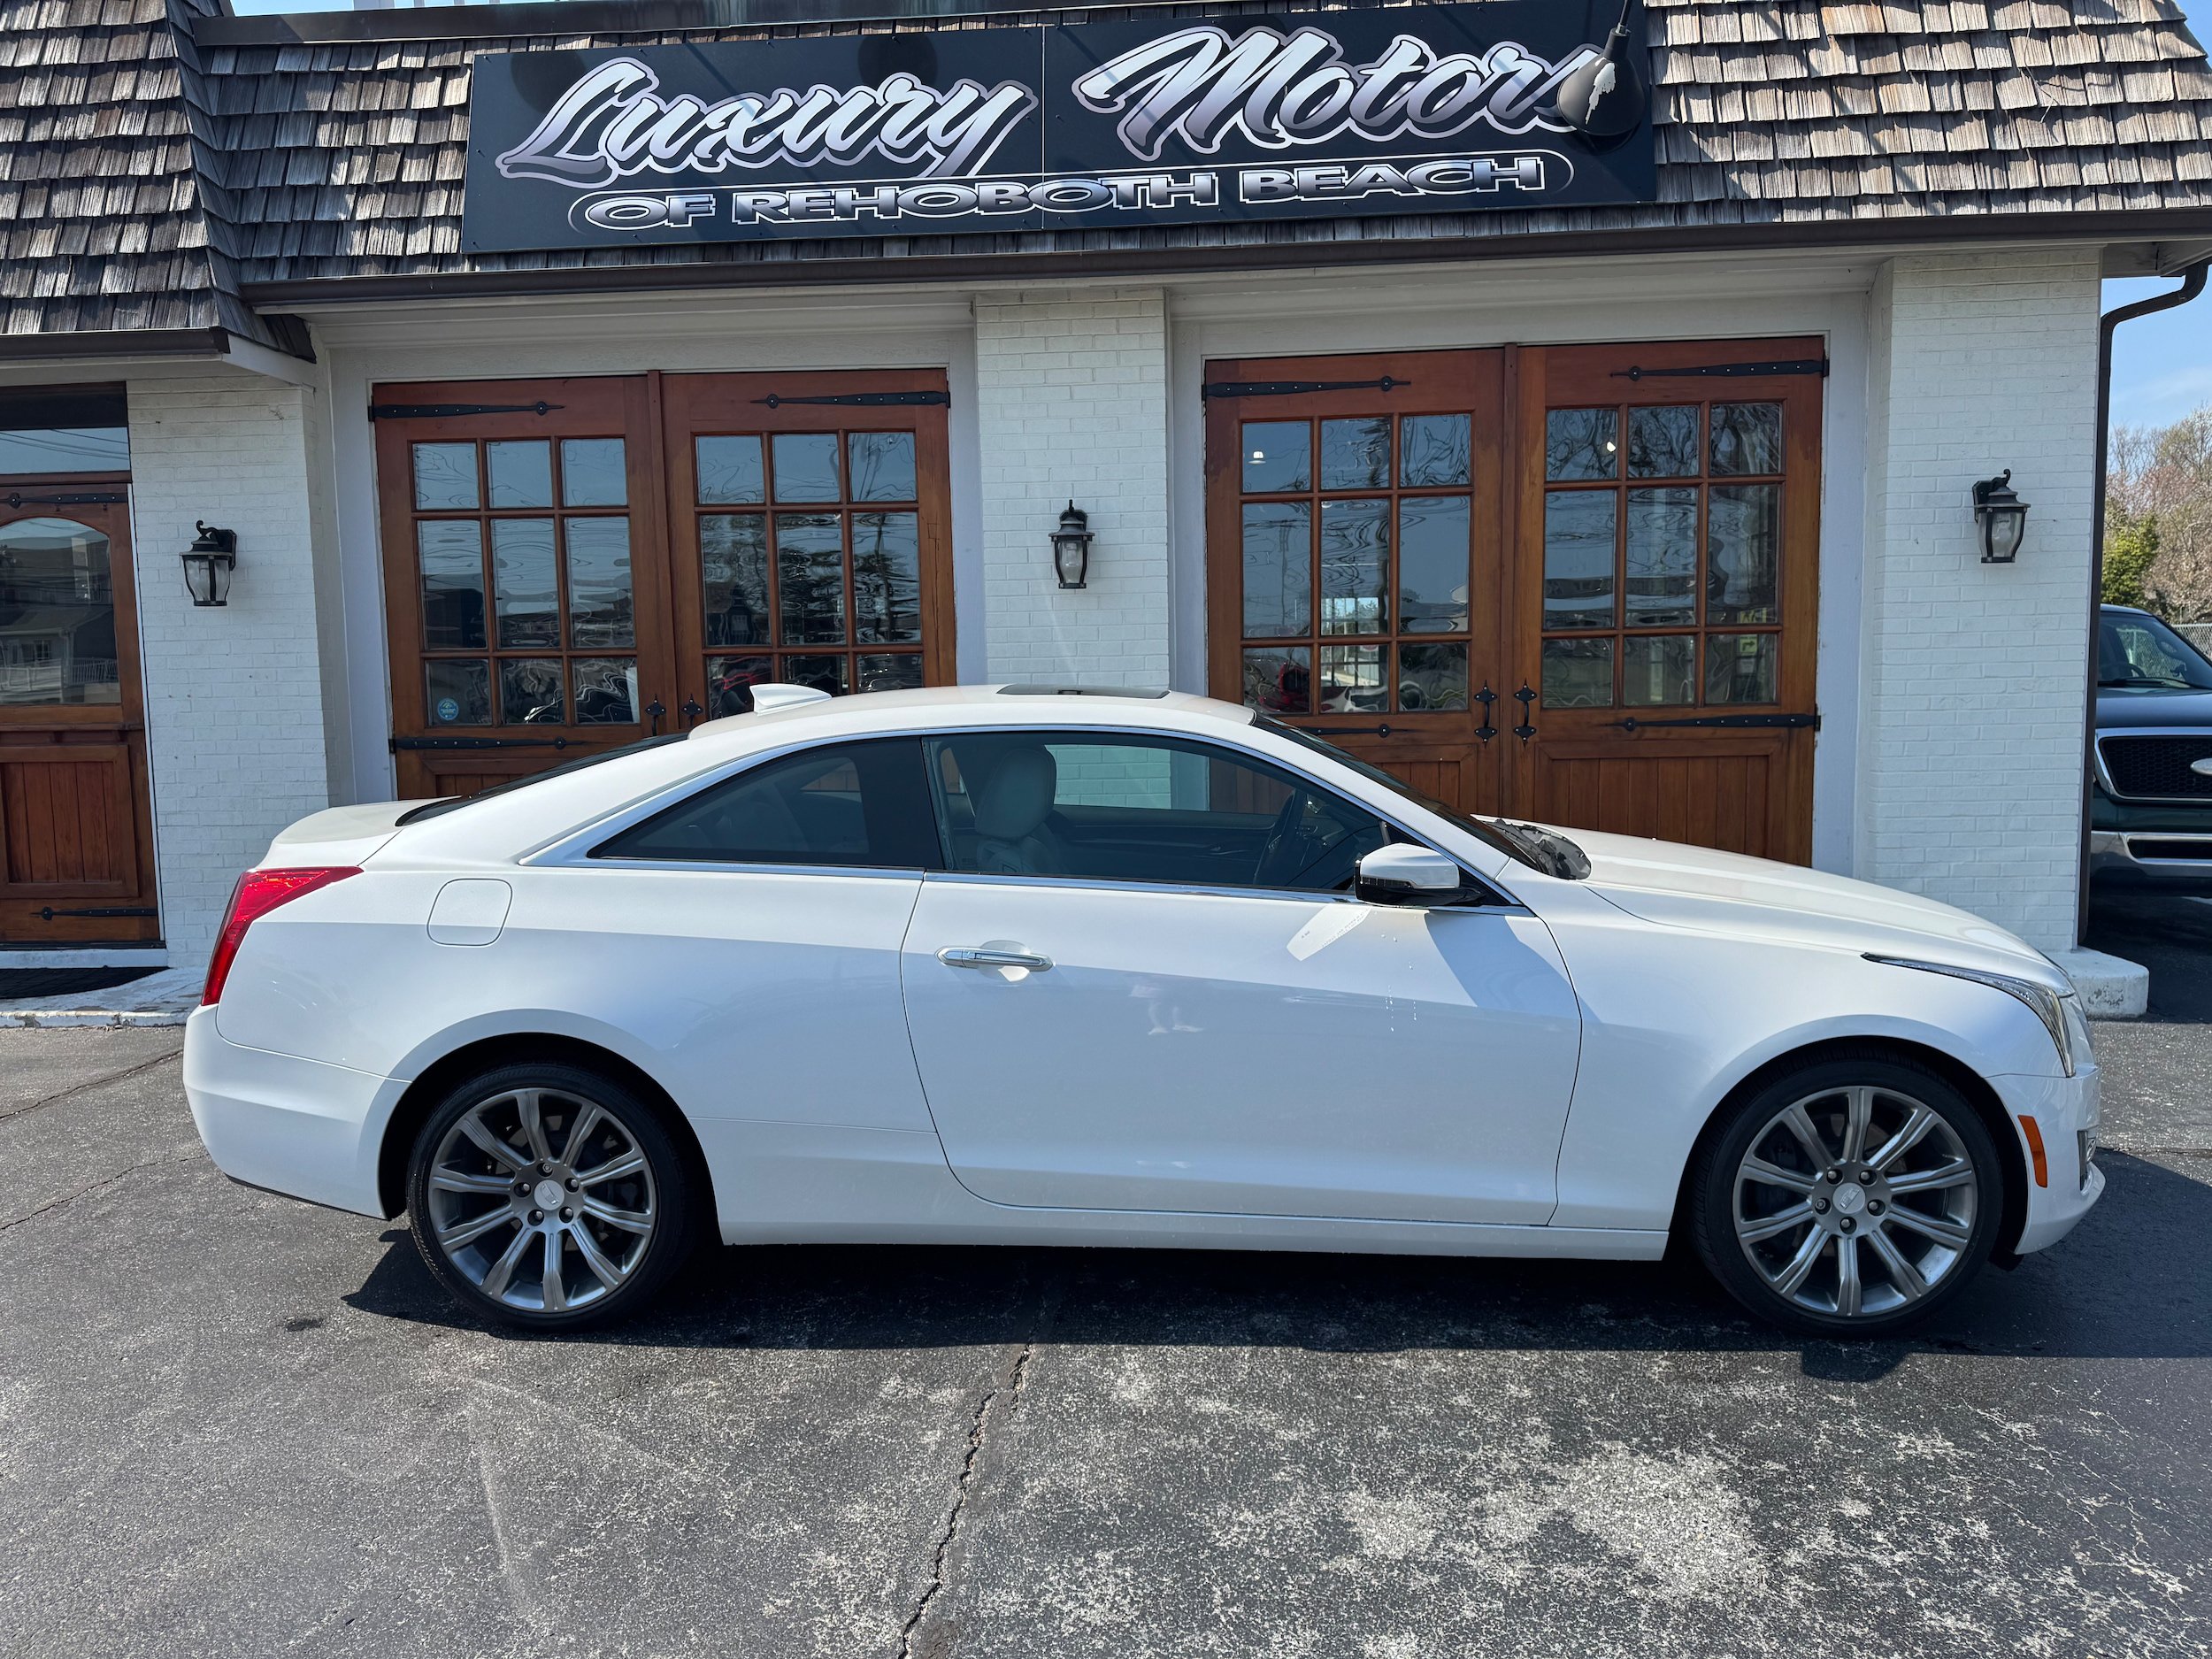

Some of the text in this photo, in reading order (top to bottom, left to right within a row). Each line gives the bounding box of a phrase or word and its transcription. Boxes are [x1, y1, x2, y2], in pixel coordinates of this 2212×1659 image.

[497, 59, 1033, 185] Luxury
[586, 157, 1544, 230] OF REHOBOTH BEACH
